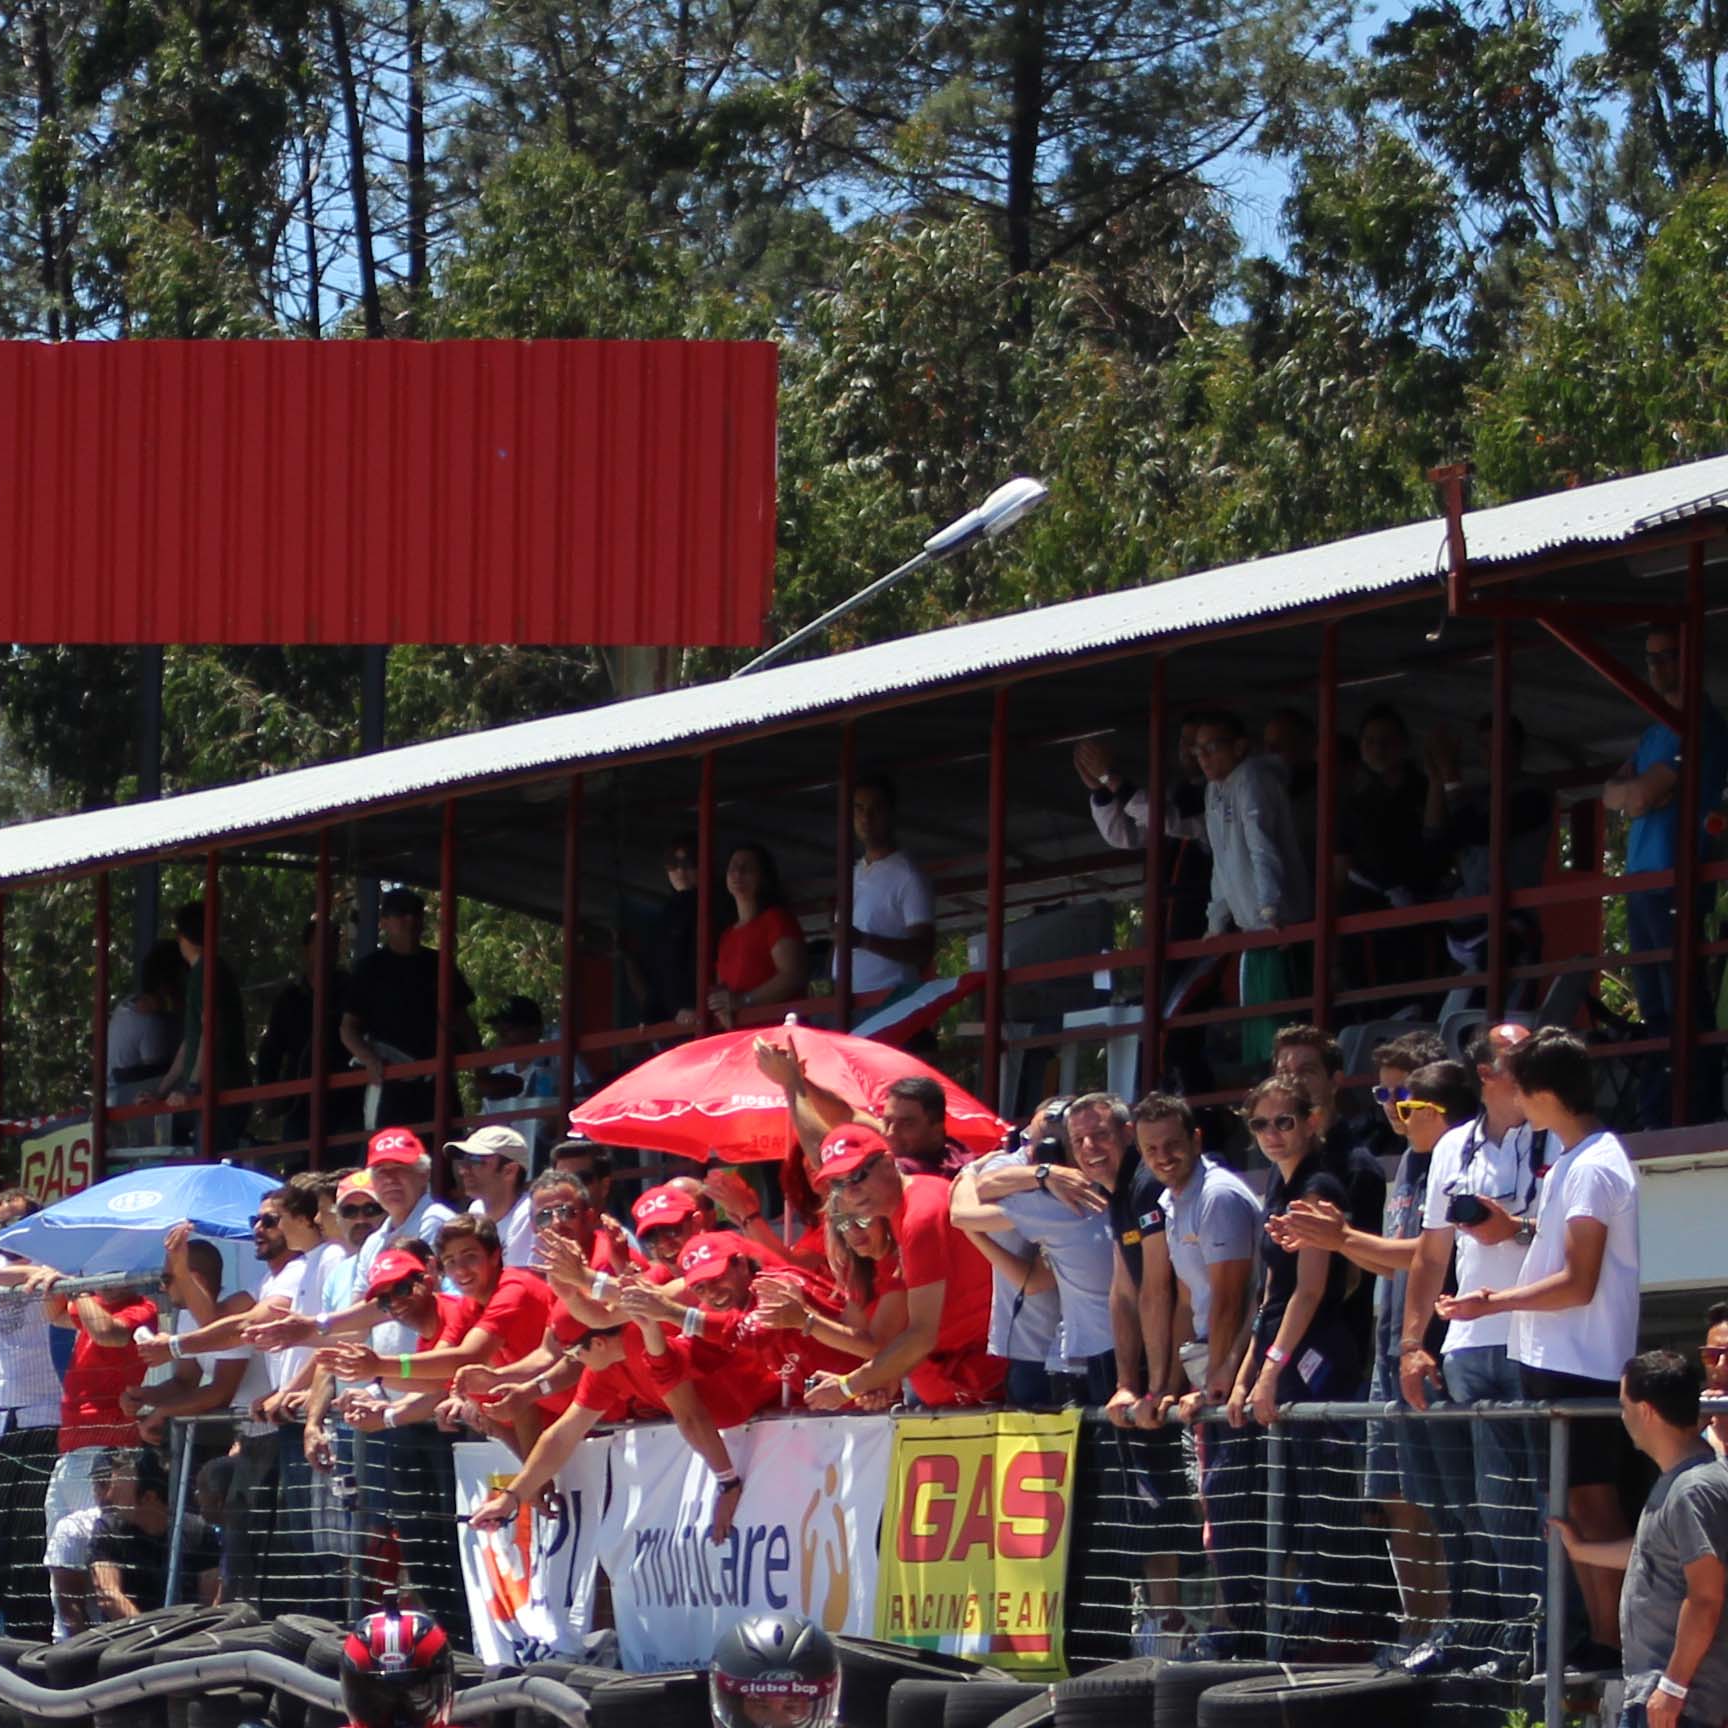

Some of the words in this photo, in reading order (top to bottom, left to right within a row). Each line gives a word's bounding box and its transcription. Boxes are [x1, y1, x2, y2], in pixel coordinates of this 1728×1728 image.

[22, 1138, 91, 1204] GAS
[896, 1450, 1068, 1563] GAS
[631, 1497, 790, 1610] multicare
[890, 1591, 977, 1631] RACING
[994, 1590, 1060, 1629] TEAM
[740, 1681, 789, 1694] clube
[792, 1681, 819, 1695] bcp
